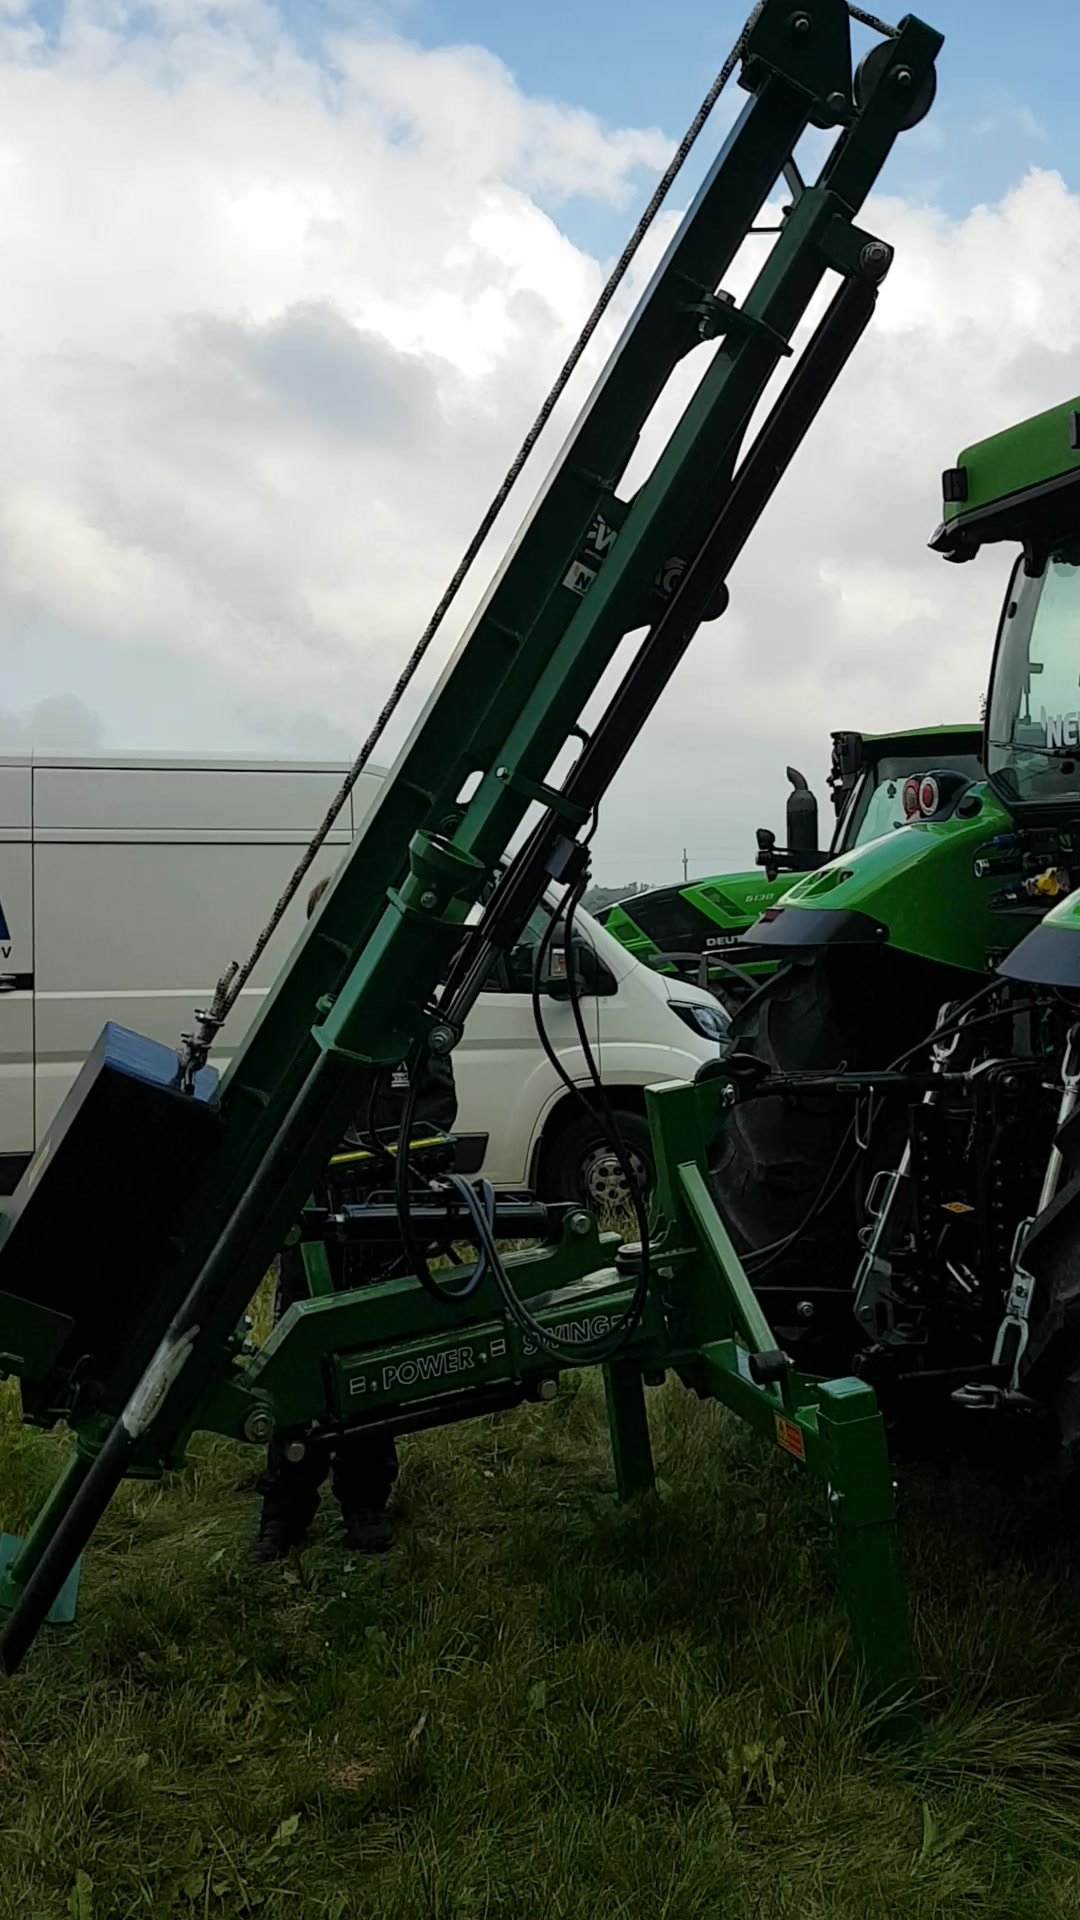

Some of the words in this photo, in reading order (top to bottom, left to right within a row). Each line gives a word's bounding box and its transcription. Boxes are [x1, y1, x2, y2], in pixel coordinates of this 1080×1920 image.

[1046, 711, 1080, 749] NE
[706, 935, 743, 946] DEUT
[383, 1347, 475, 1389] POWER
